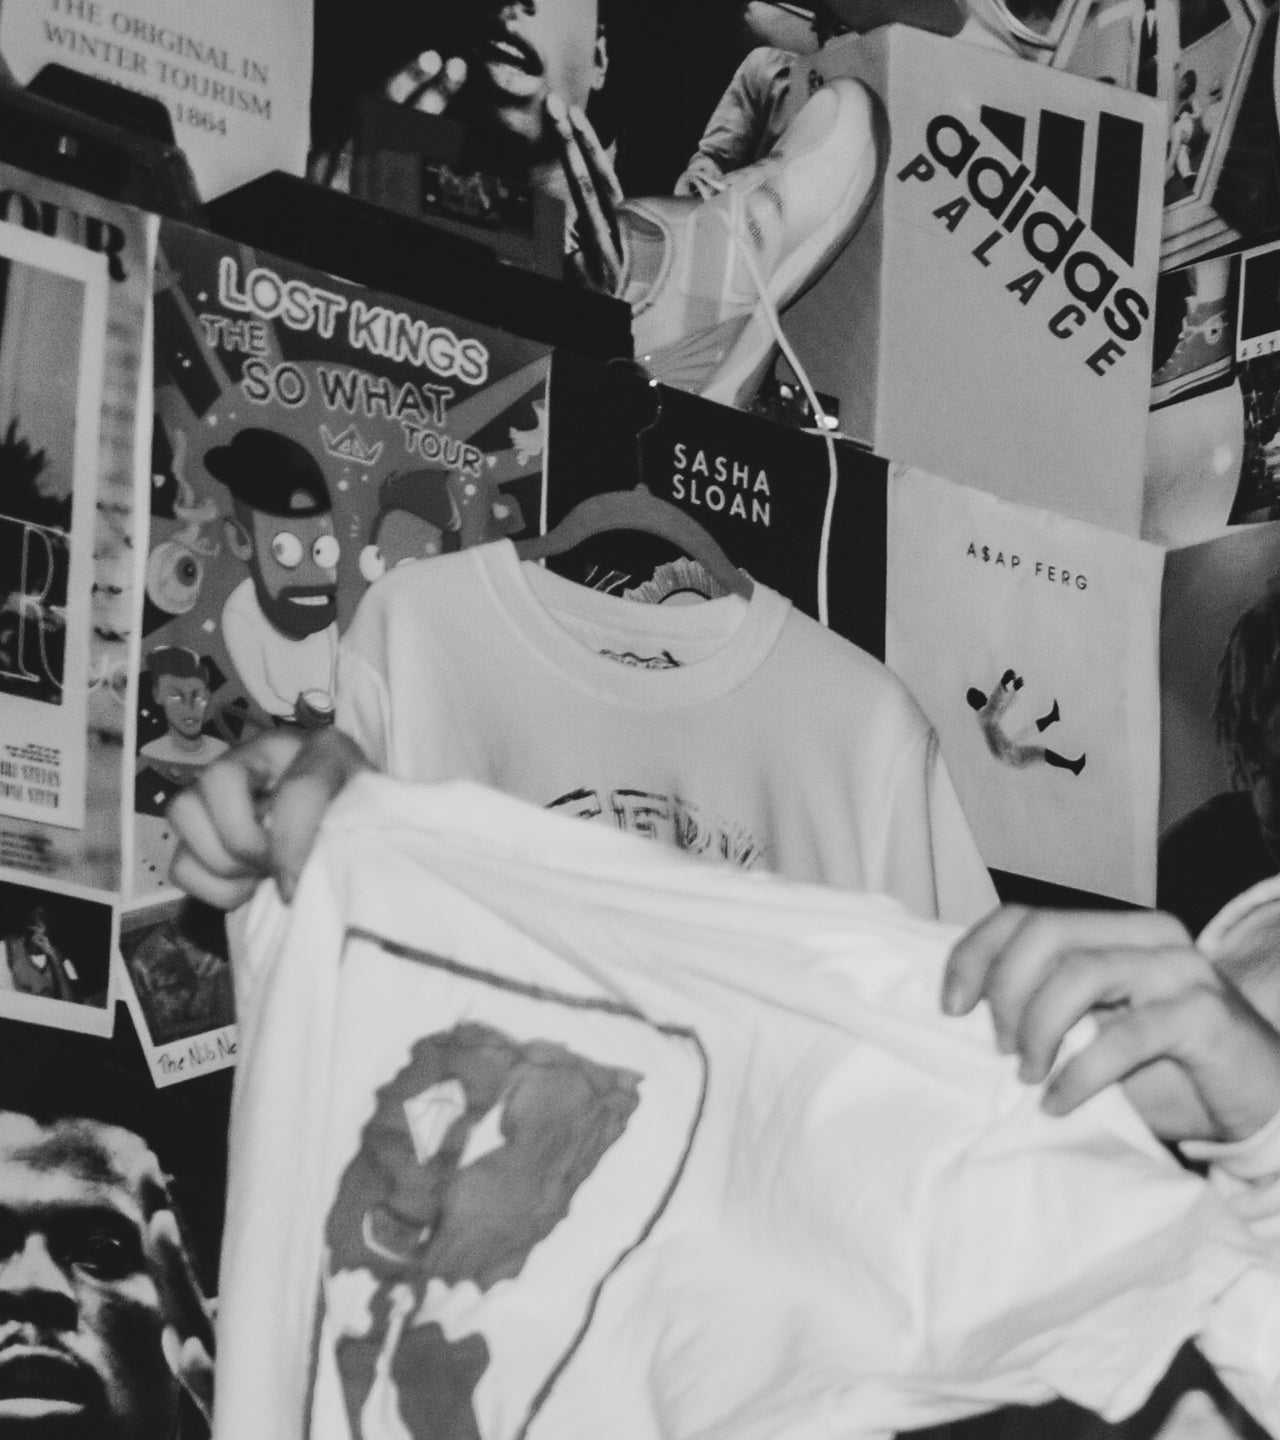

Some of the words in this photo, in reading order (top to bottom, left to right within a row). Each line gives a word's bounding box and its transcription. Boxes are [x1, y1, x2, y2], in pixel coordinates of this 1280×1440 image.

[43, 19, 148, 76] WINTER
[157, 59, 273, 121] TOURISM
[111, 12, 235, 75] ORIGINAL
[242, 58, 269, 85] IN
[176, 102, 228, 137] 1864
[925, 113, 1150, 343] adidas
[896, 153, 1127, 377] PALACE
[200, 312, 269, 356] THE
[218, 256, 346, 339] LOST
[348, 300, 489, 385] KINGS
[241, 356, 306, 407] SO
[317, 365, 456, 427] WHAT
[399, 419, 484, 477] TOUR
[672, 442, 772, 498] SASHA
[672, 473, 772, 528] SLOAN
[966, 541, 1022, 571] A$AP
[1034, 560, 1090, 592] FERG
